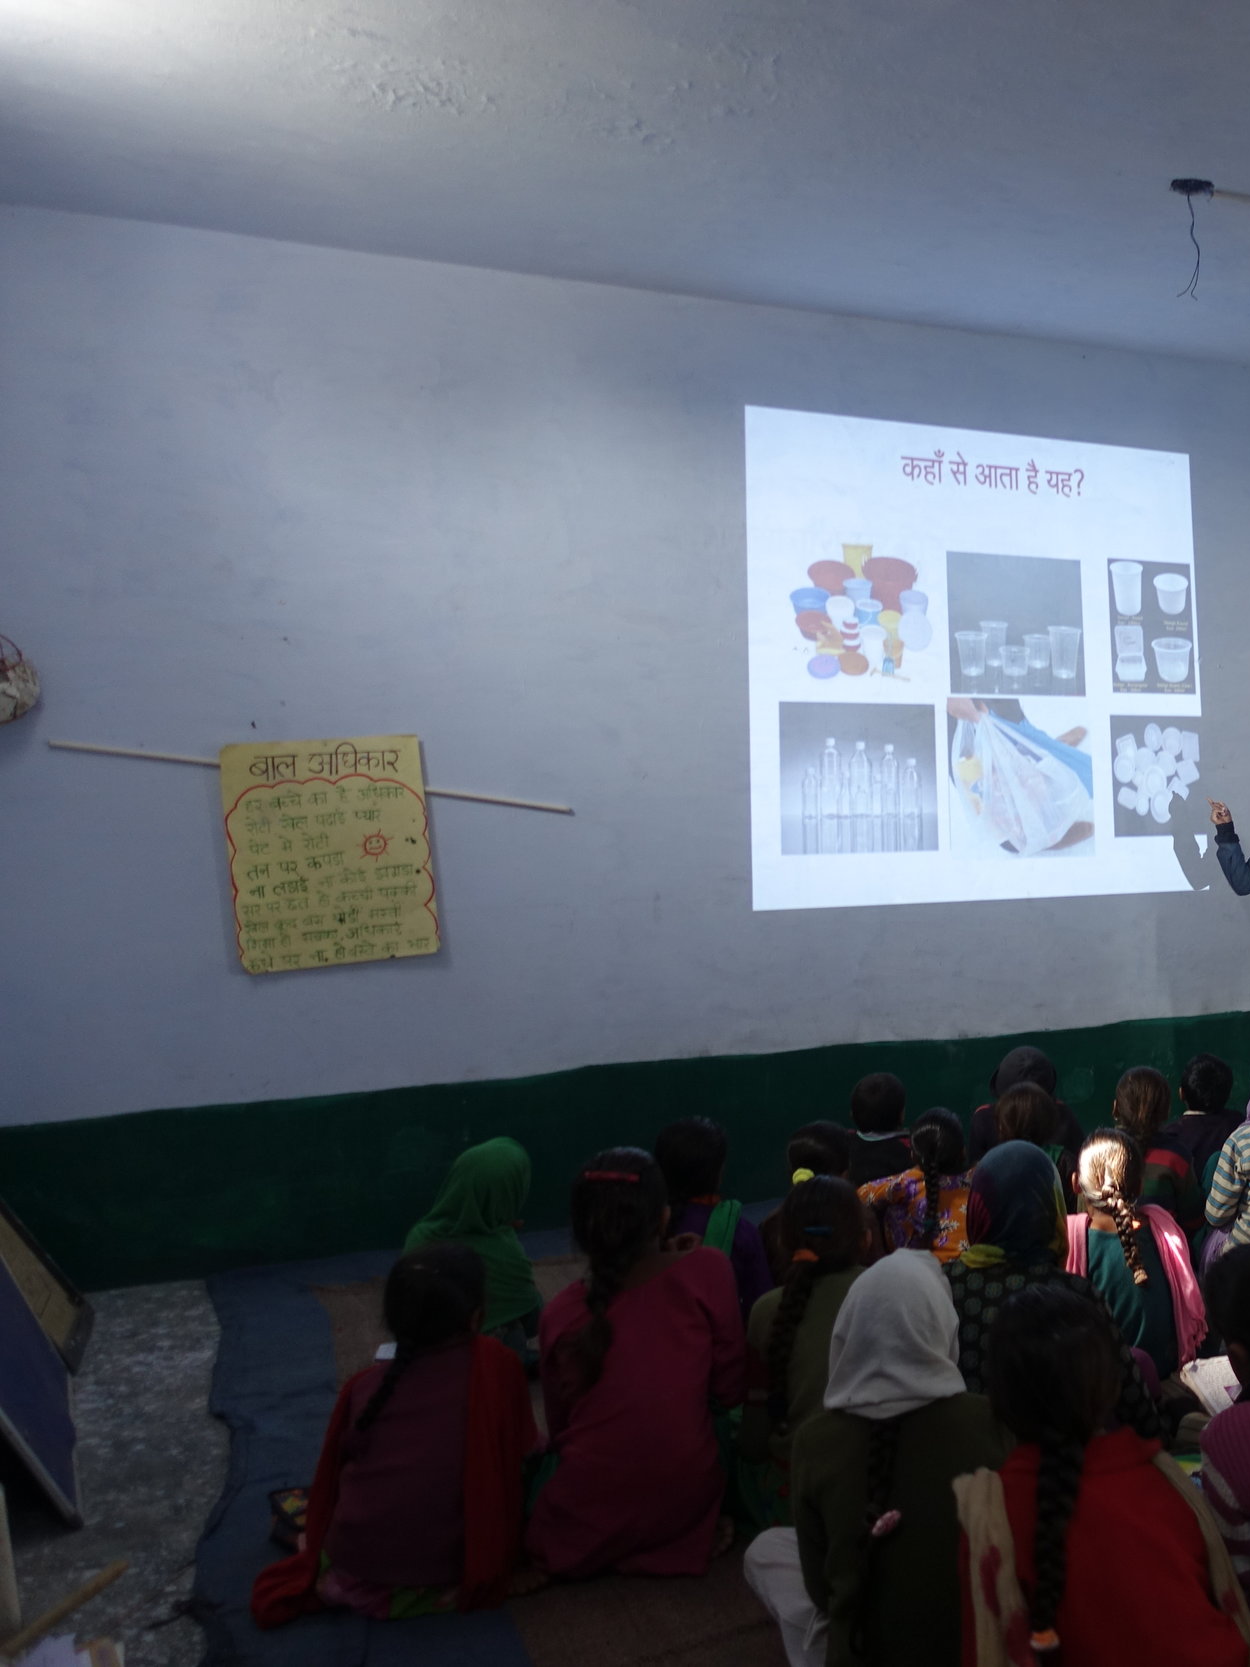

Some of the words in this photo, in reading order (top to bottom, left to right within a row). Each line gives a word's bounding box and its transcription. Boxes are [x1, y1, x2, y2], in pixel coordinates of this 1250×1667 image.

[901, 448, 944, 486] कहाँ
[948, 451, 968, 487] से
[975, 464, 1020, 491] आता
[1025, 458, 1039, 495] है
[1045, 468, 1085, 498] यह?
[249, 754, 298, 782] बाल
[308, 742, 401, 776] अधिकार
[247, 863, 271, 881] तन
